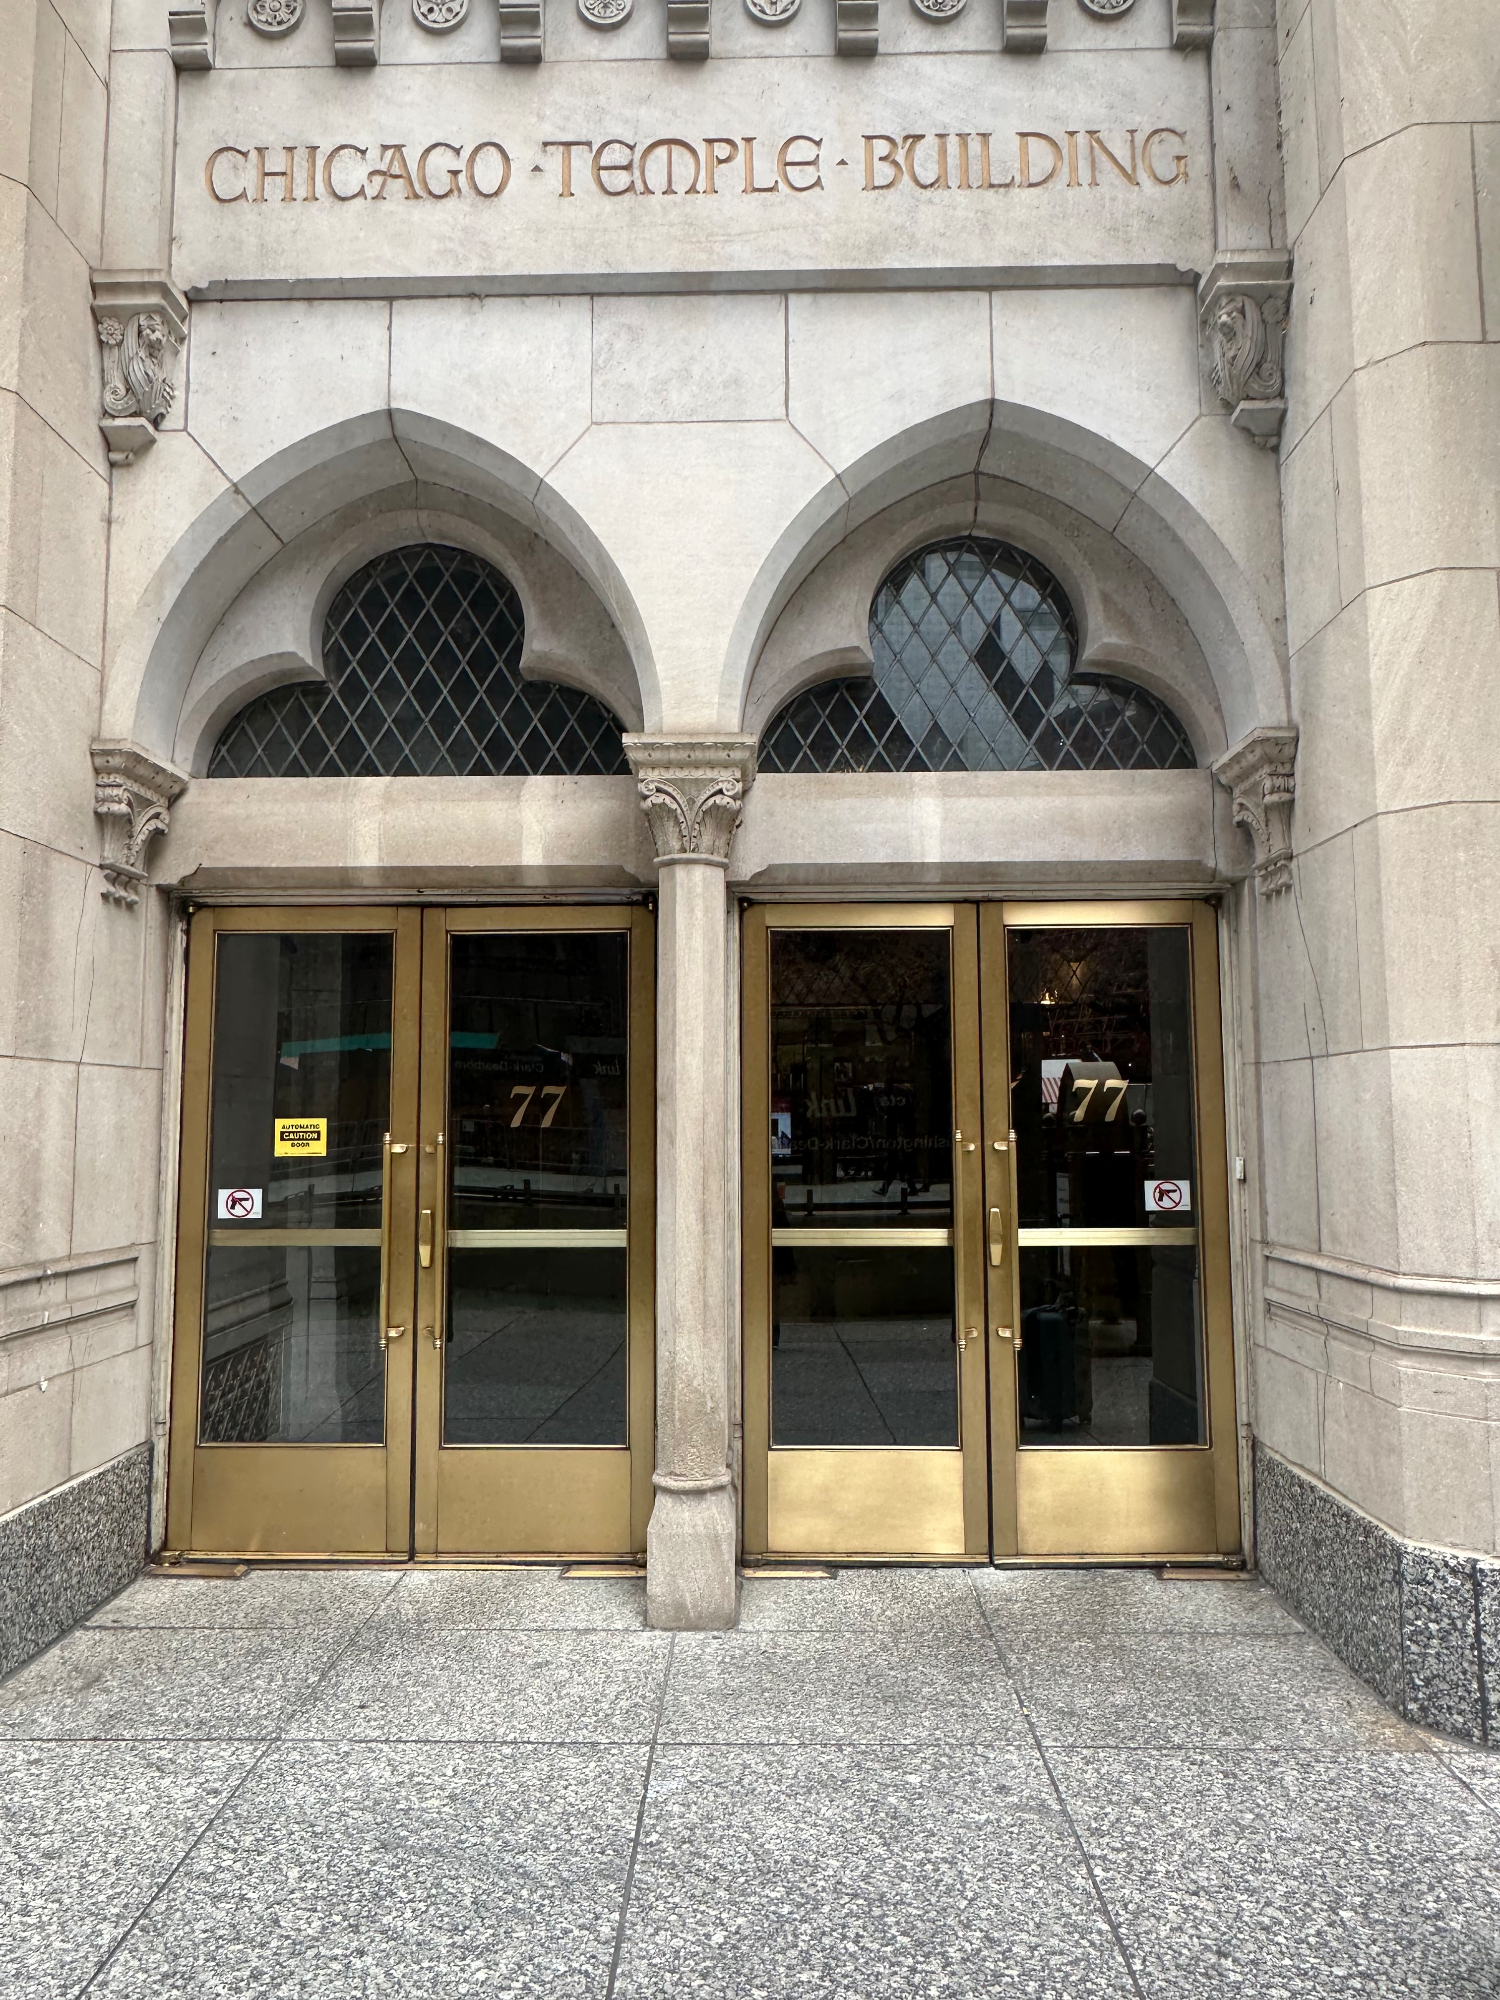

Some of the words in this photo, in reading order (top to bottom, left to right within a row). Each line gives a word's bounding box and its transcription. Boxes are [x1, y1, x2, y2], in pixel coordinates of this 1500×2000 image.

[205, 141, 512, 203] CHICAGO
[541, 136, 825, 198] TEMPLE
[861, 127, 1189, 192] BUILDING
[510, 1086, 567, 1128] 77
[1072, 1079, 1129, 1122] 77
[283, 1132, 318, 1140] CAUTION
